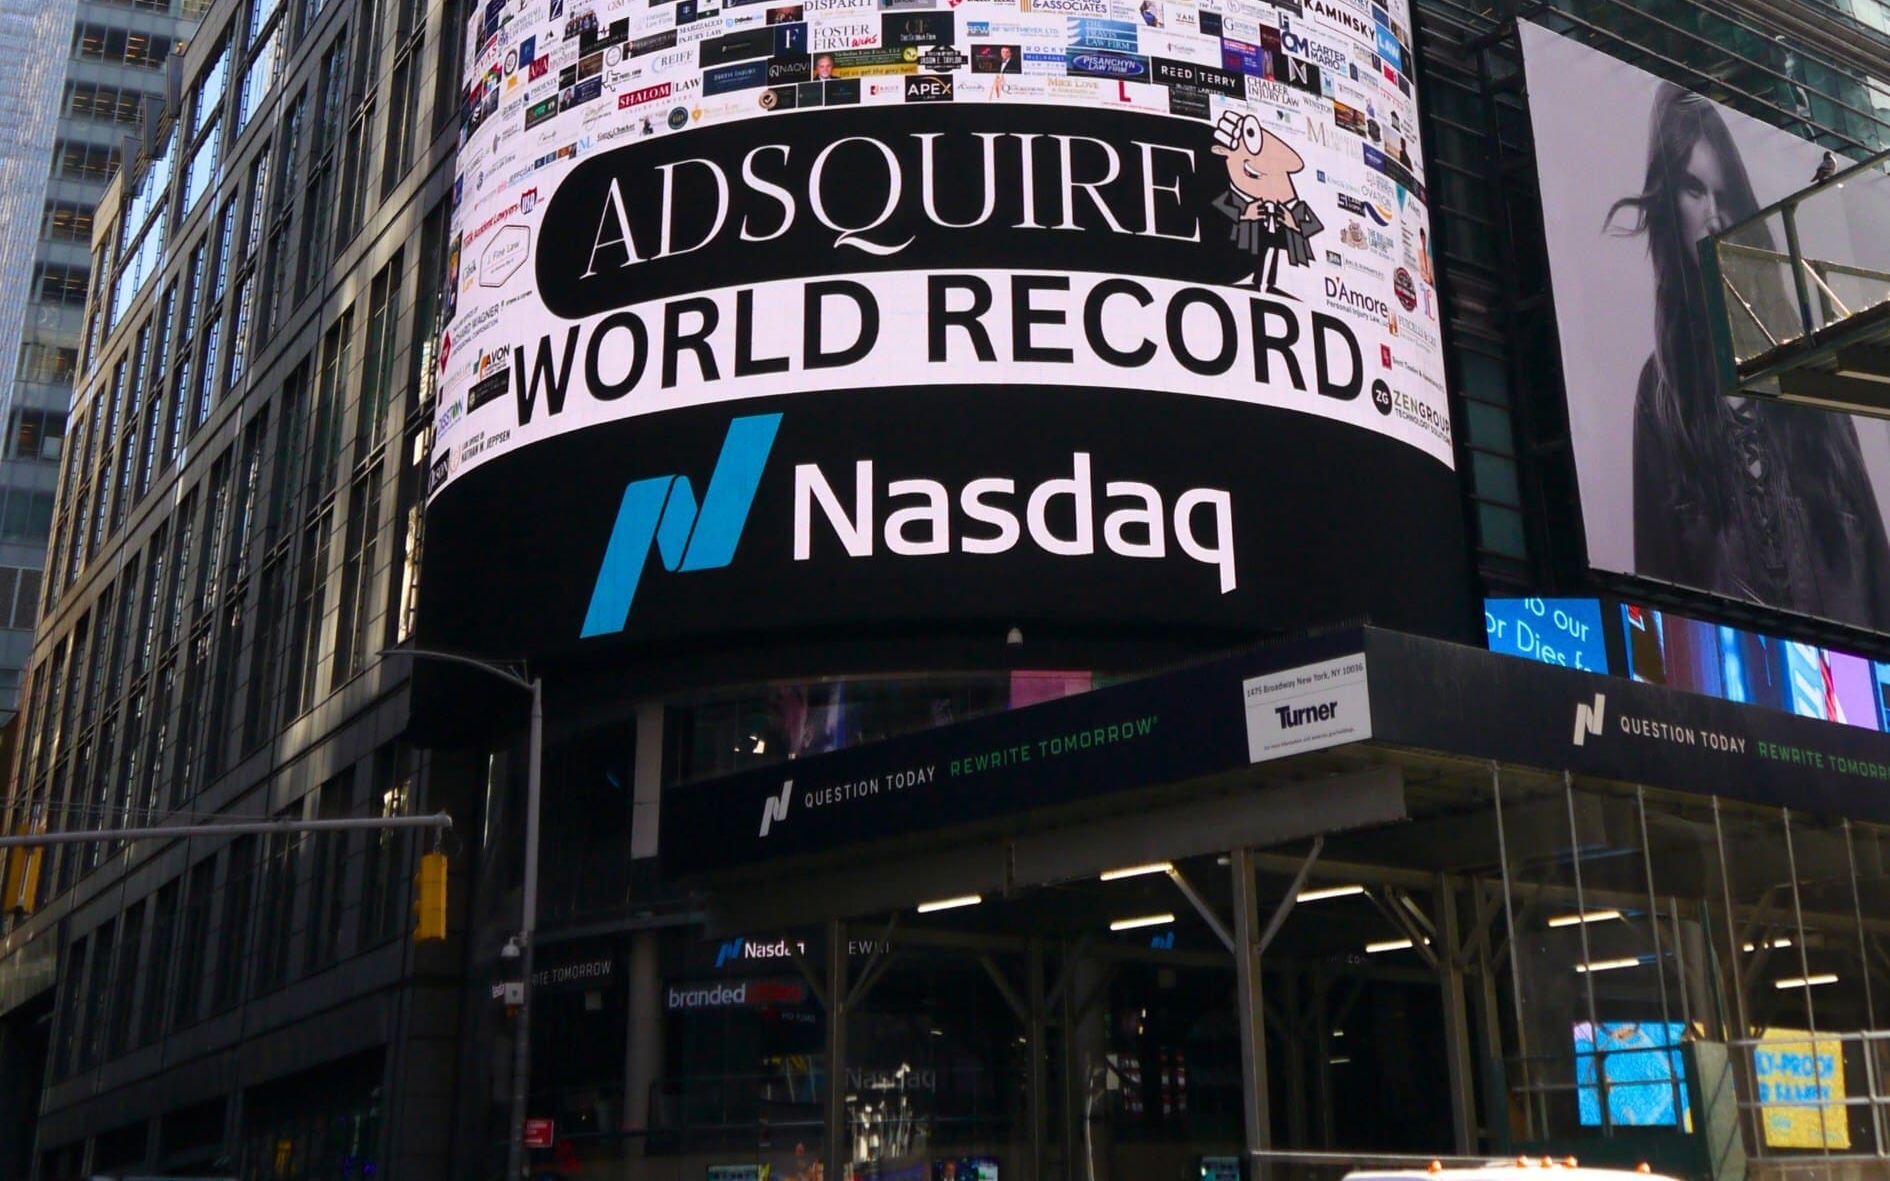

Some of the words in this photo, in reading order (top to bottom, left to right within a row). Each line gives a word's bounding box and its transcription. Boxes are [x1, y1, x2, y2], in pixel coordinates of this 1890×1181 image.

[814, 24, 870, 38] FOSTER
[814, 36, 850, 50] FIRM
[1310, 40, 1347, 62] CARTER
[1377, 35, 1400, 60] LAW
[1310, 51, 1341, 71] MARIO
[1160, 65, 1193, 81] REED
[1199, 72, 1237, 88] TERRY
[1247, 77, 1289, 95] CHALKER
[618, 85, 672, 108] SHALOM
[907, 83, 953, 96] APEX
[579, 131, 1202, 280] ADSQUIRE
[1325, 276, 1389, 317] D'Amore
[486, 343, 510, 365] AVON
[513, 280, 880, 427] WORLD
[927, 274, 1364, 402] RECORD
[1375, 391, 1390, 404] ZG
[793, 451, 1237, 595] Nasdaq
[1553, 609, 1589, 642] our
[1263, 680, 1296, 694] Broadway
[1296, 676, 1312, 685] New
[1313, 671, 1330, 682] York,
[1331, 669, 1341, 677] NY
[1275, 701, 1338, 729] Turner
[1620, 715, 1696, 746] QUESTION
[1701, 731, 1747, 755] TODAY
[1758, 740, 1824, 769] REWRITE
[805, 779, 879, 809] QUESTION
[886, 765, 936, 791] TODAY
[950, 745, 1032, 778] REWRITE
[669, 982, 746, 1009] branded
